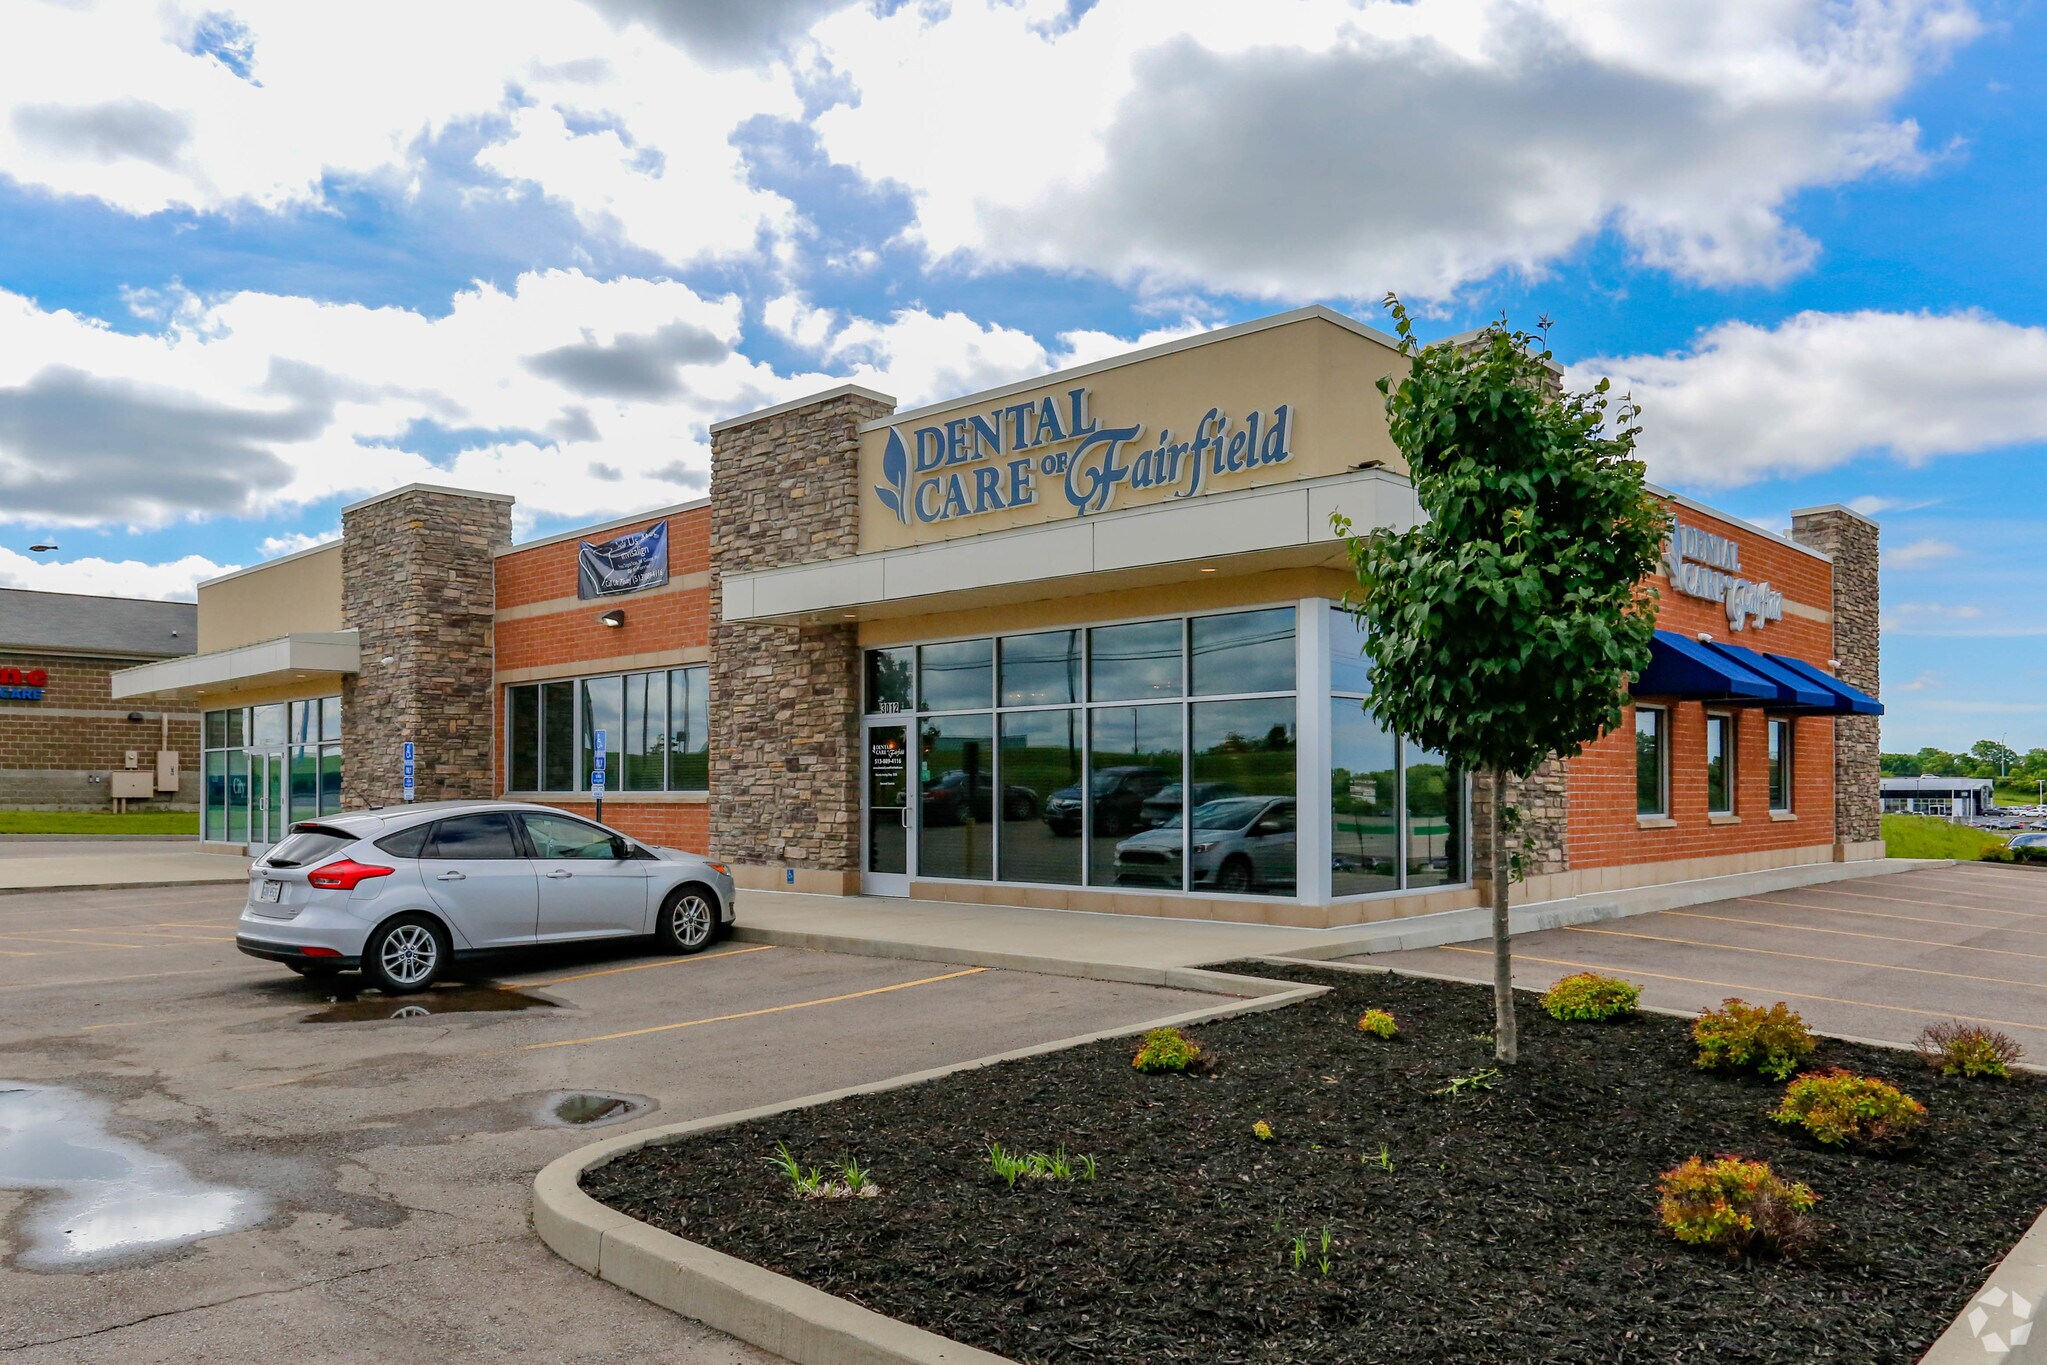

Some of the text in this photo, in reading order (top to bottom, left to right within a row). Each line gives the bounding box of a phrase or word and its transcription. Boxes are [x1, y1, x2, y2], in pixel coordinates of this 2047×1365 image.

[914, 388, 1099, 474] DENTAL
[915, 404, 1292, 523] CARE OF Fairfield
[627, 536, 639, 546] Us
